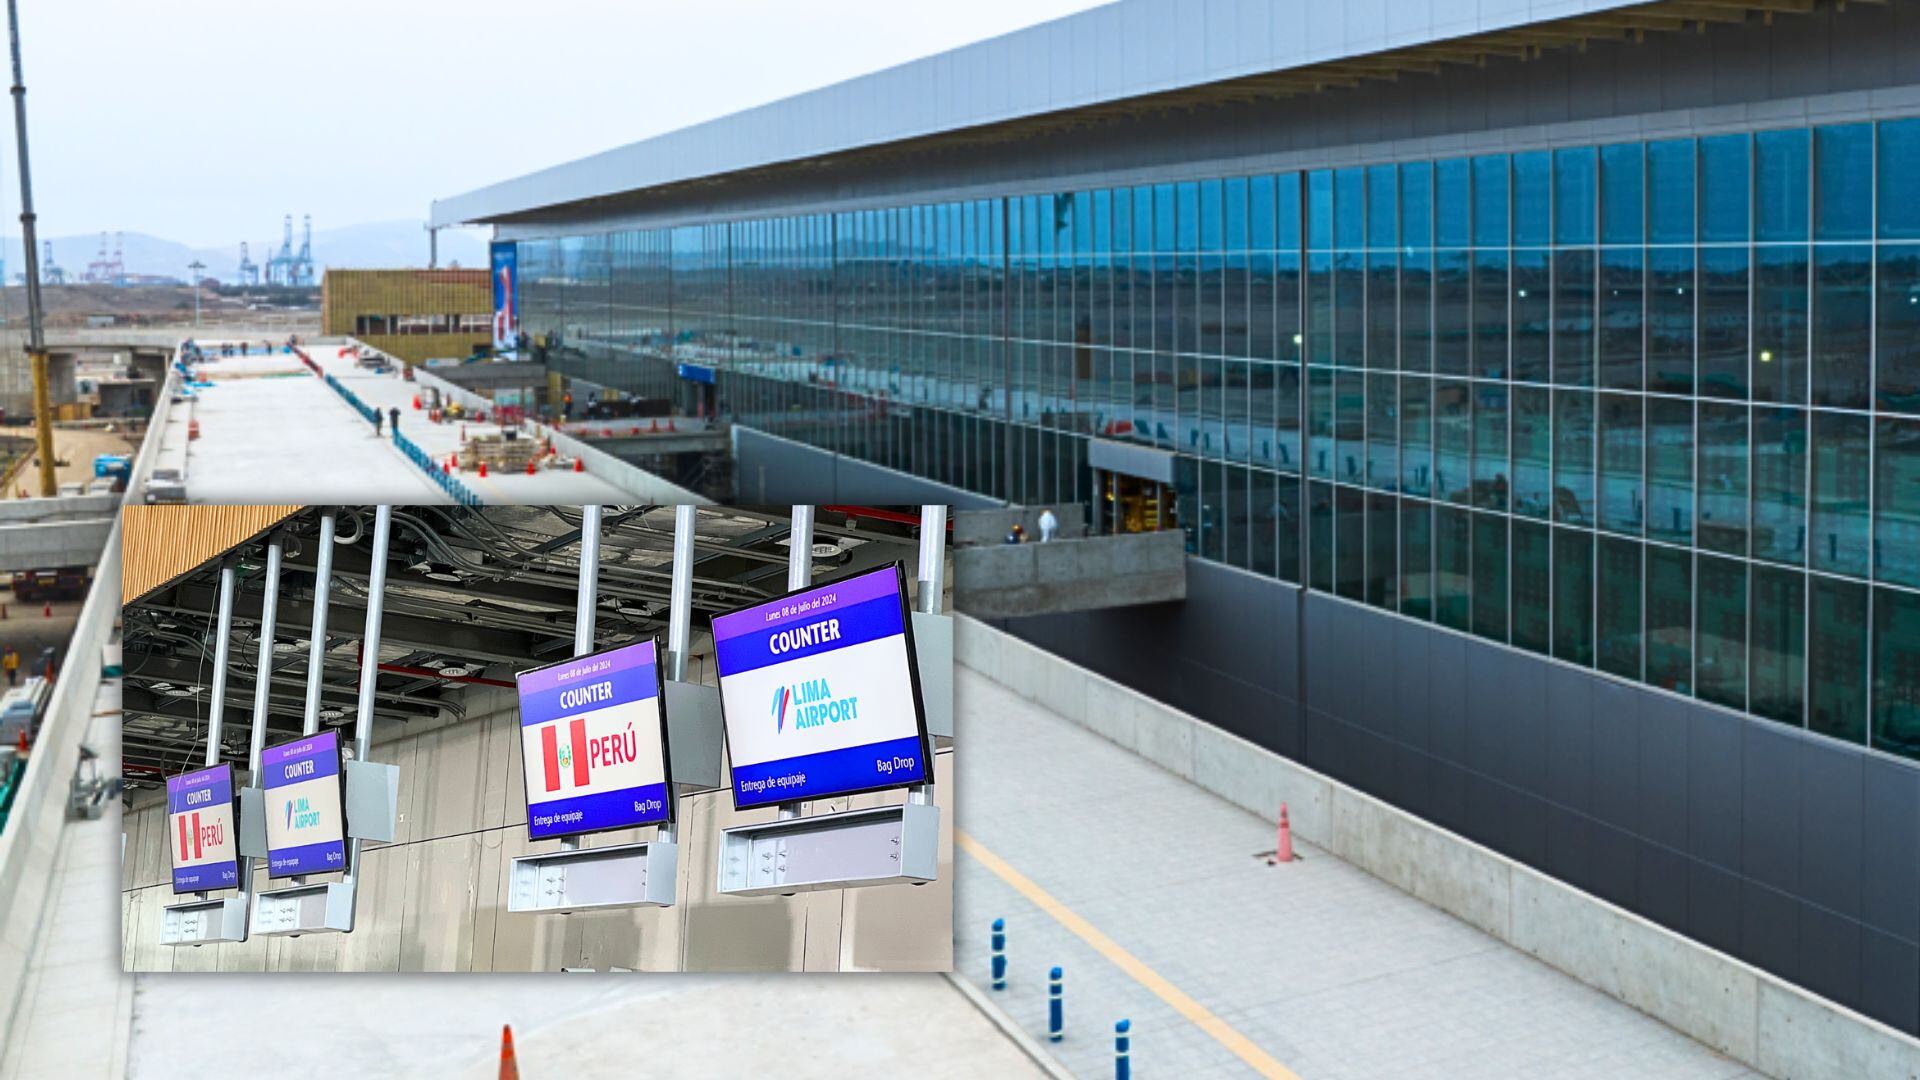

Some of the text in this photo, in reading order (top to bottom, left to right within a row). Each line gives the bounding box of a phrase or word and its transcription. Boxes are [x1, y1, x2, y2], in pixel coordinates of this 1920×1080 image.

[765, 611, 780, 622] Lunes
[782, 606, 790, 617] 08
[790, 604, 797, 614] de
[812, 597, 820, 608] del
[822, 593, 837, 606] 2024
[769, 618, 841, 655] COUNTER
[560, 681, 613, 710] COUNTER
[792, 678, 832, 706] LIMA
[796, 696, 858, 730] AIRPORT
[590, 722, 637, 769] PERÚ
[284, 760, 314, 779] COUNTER
[876, 756, 914, 775] Bag Drop
[740, 771, 806, 793] Entrega de equipaje
[186, 789, 212, 805] COUNTER
[294, 796, 310, 813] LIMA
[634, 799, 662, 814] Bag Drop
[294, 811, 320, 830] AIRPORT
[534, 810, 583, 828] Entrega de equipaje
[202, 817, 224, 847] PERÚ
